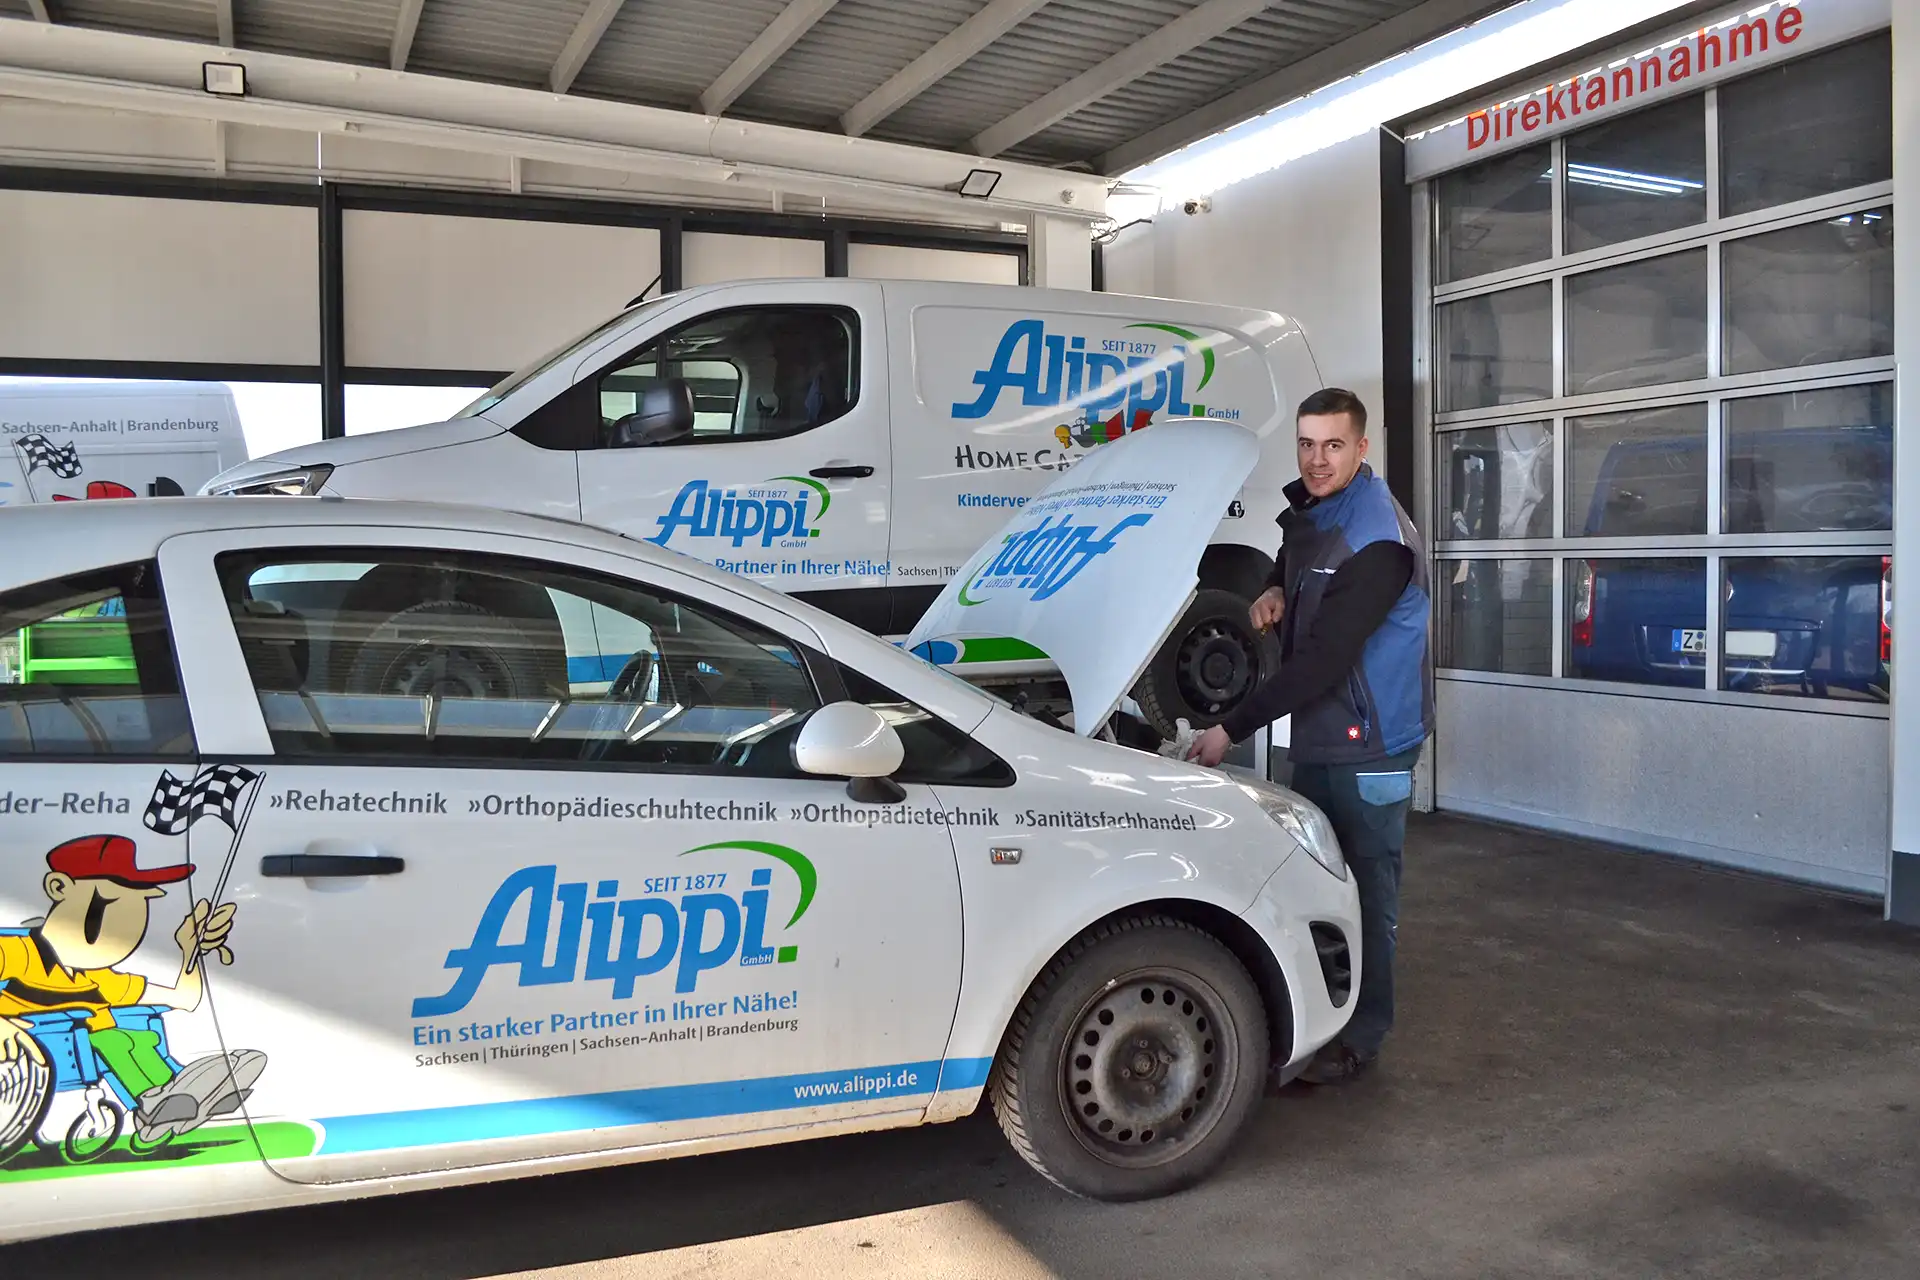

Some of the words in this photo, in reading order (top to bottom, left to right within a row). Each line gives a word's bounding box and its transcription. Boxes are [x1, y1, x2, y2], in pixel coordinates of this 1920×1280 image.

[1467, 6, 1803, 150] Direktannahme
[1102, 339, 1126, 352] SEIT
[1129, 342, 1157, 354] 1877
[951, 319, 1190, 428] Alippi
[1207, 407, 1240, 419] GmbH
[1, 420, 117, 435] Sachsen-Anhalt
[127, 418, 219, 432] Brandenburg
[748, 489, 765, 498] SEIT
[767, 490, 788, 498] 1877
[643, 479, 809, 548] Alippi
[780, 540, 807, 548] GmbH
[973, 513, 1154, 601] Alippi
[781, 560, 797, 574] in
[801, 560, 841, 575] Ihrer
[844, 560, 891, 576] Nähe!
[897, 566, 938, 576] Sachsen
[643, 876, 681, 894] SEIT
[684, 873, 727, 891] 1877
[411, 864, 775, 1018] Alippi
[741, 953, 773, 965] GmbH
[412, 1024, 452, 1046] Ein
[458, 1017, 544, 1042] starker
[550, 1007, 639, 1033] Partner
[644, 1003, 666, 1023] in
[672, 997, 727, 1021] Ihrer
[733, 990, 799, 1014] Nähe!
[415, 1050, 480, 1067] Sachsen
[490, 1040, 569, 1061] Thüringen
[579, 1026, 697, 1051] Sachsen-Anhalt
[706, 1017, 799, 1038] Brandenburg
[794, 1070, 918, 1098] www.alippi.de
